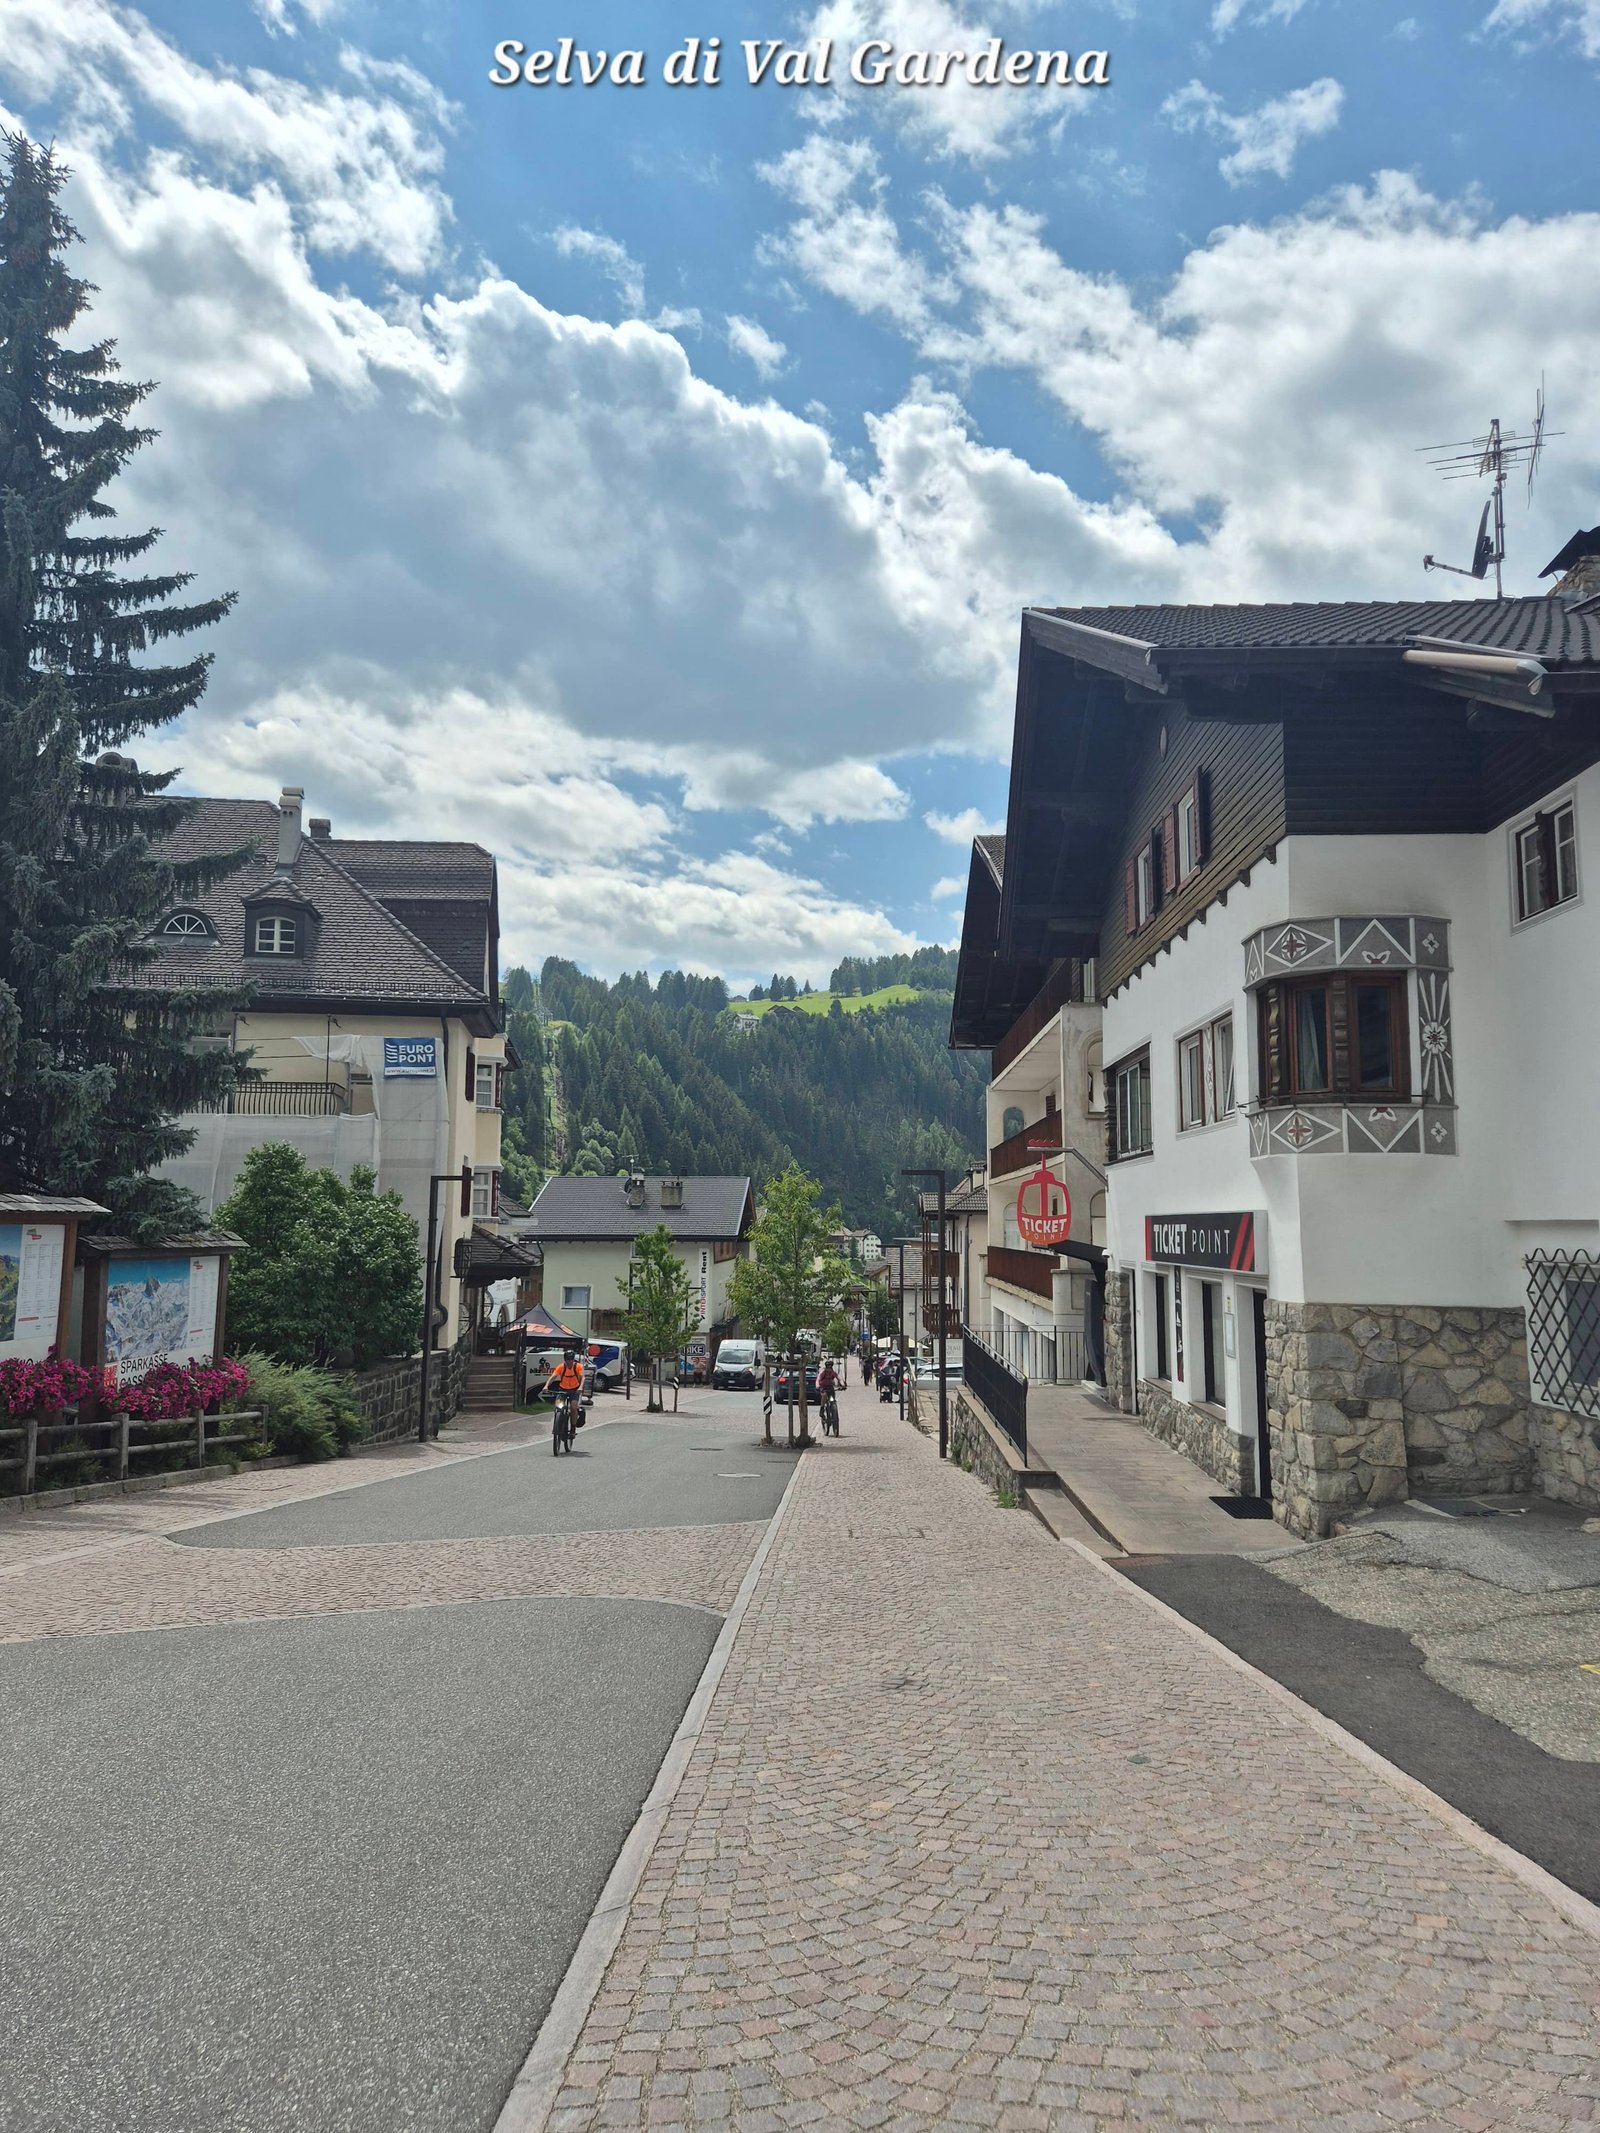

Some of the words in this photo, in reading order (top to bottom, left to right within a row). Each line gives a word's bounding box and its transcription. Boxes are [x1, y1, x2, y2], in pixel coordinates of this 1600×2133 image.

[399, 1044, 434, 1054] EURO
[399, 1053, 434, 1063] PONT
[1022, 1217, 1067, 1234] TICKET
[1025, 1232, 1063, 1241] POINT
[1153, 1224, 1187, 1254] TICKET
[1192, 1229, 1230, 1254] POINT
[120, 1353, 168, 1374] SPARKASSE
[120, 1374, 143, 1386] CASS
